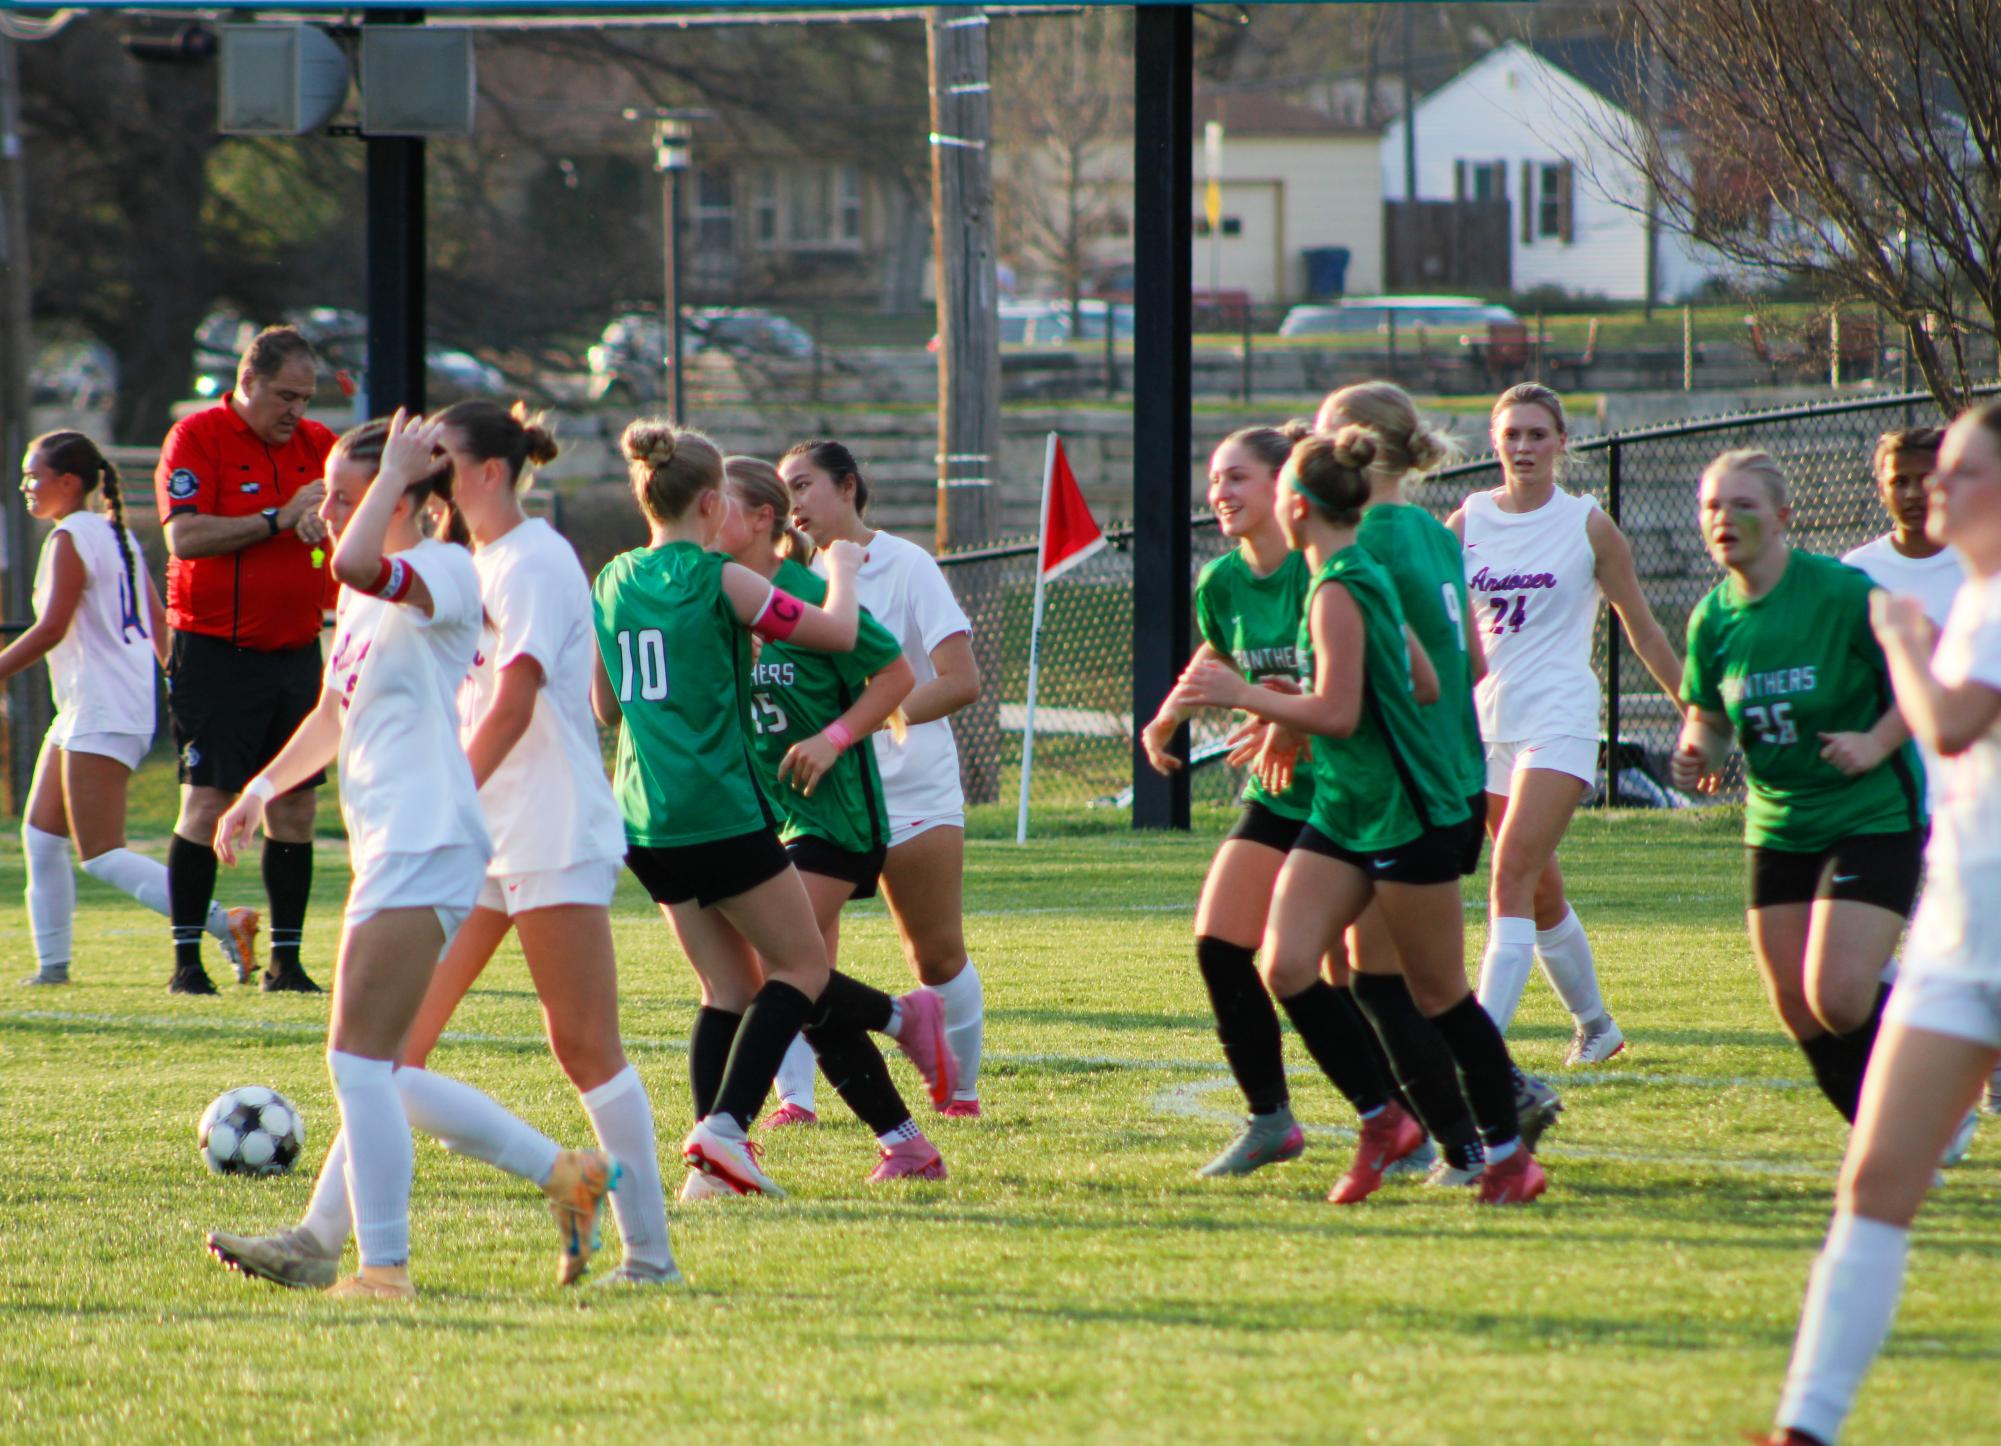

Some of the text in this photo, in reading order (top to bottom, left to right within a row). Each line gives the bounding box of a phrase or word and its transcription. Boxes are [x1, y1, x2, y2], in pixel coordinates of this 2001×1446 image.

[772, 597, 799, 622] C
[1441, 582, 1466, 652] 9
[617, 629, 668, 703] 10
